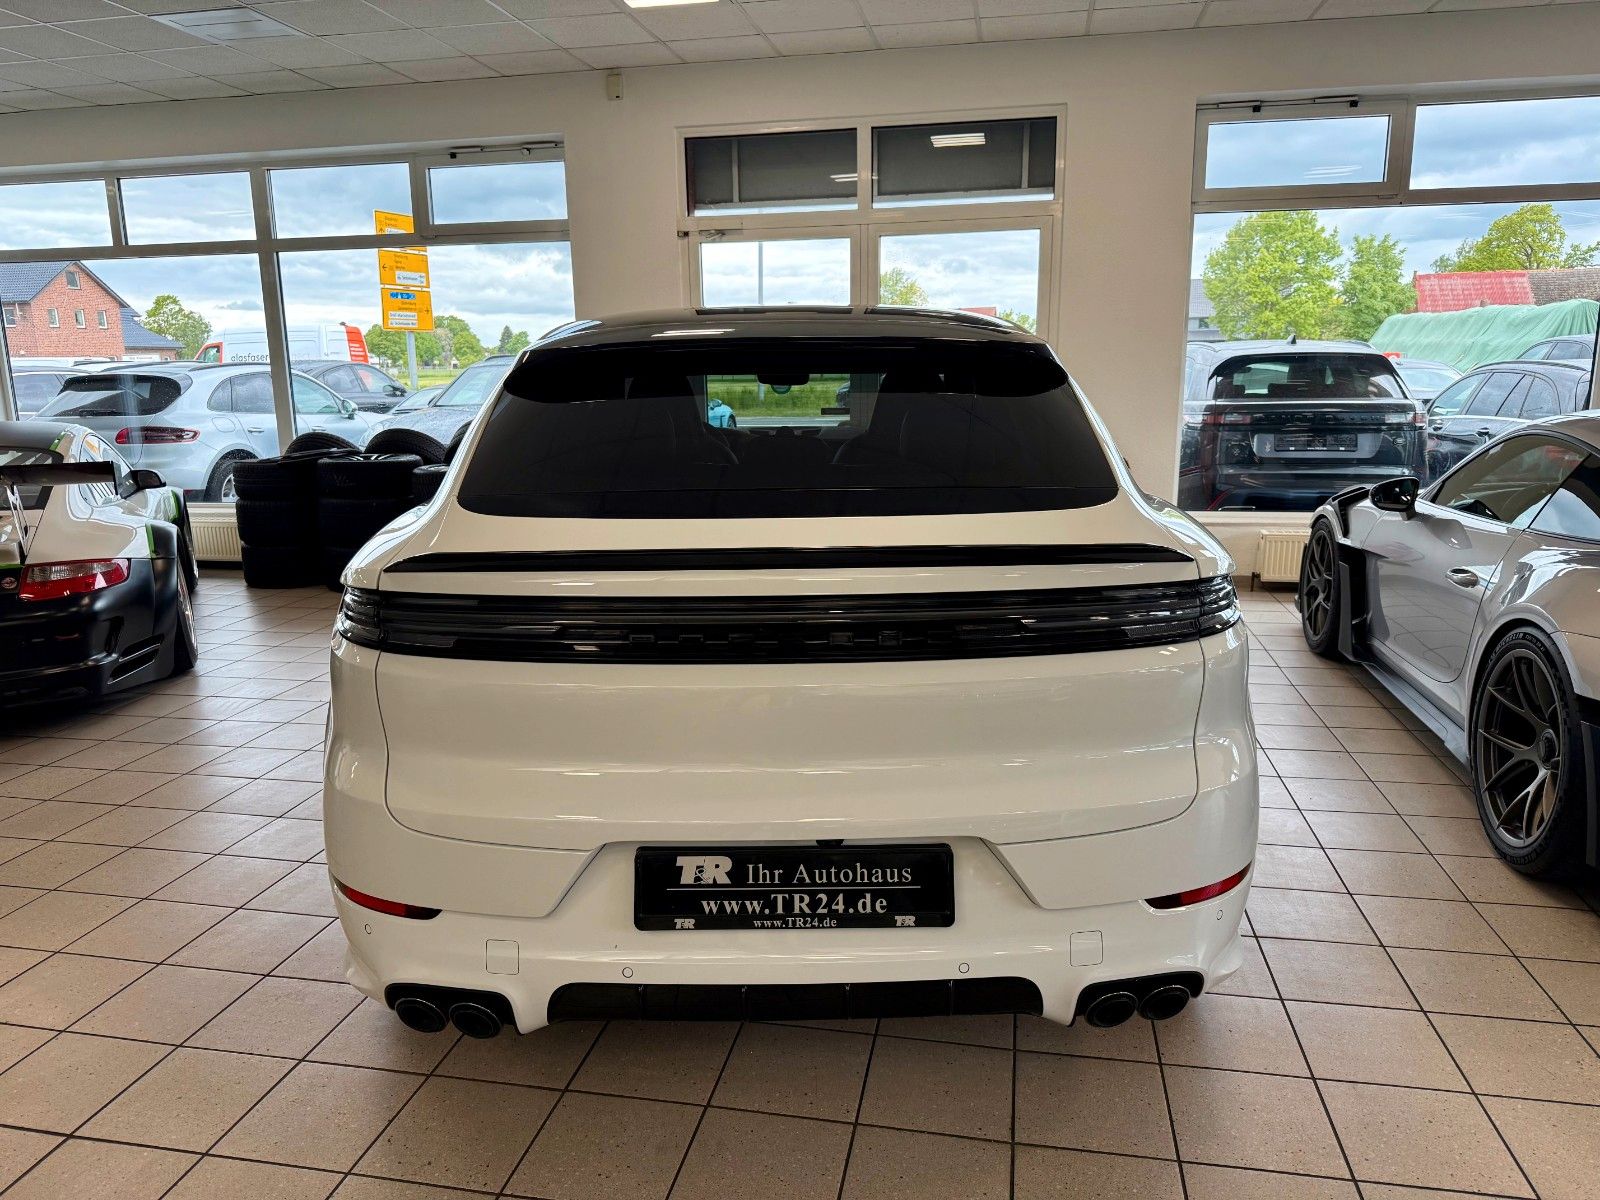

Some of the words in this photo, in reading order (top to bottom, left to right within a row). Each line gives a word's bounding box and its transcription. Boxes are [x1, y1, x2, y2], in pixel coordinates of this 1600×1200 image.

[746, 863, 784, 884] Ihr
[791, 862, 912, 884] Autohaus
[701, 892, 888, 915] www.TR24.de
[753, 916, 837, 929] www.TR24.de
